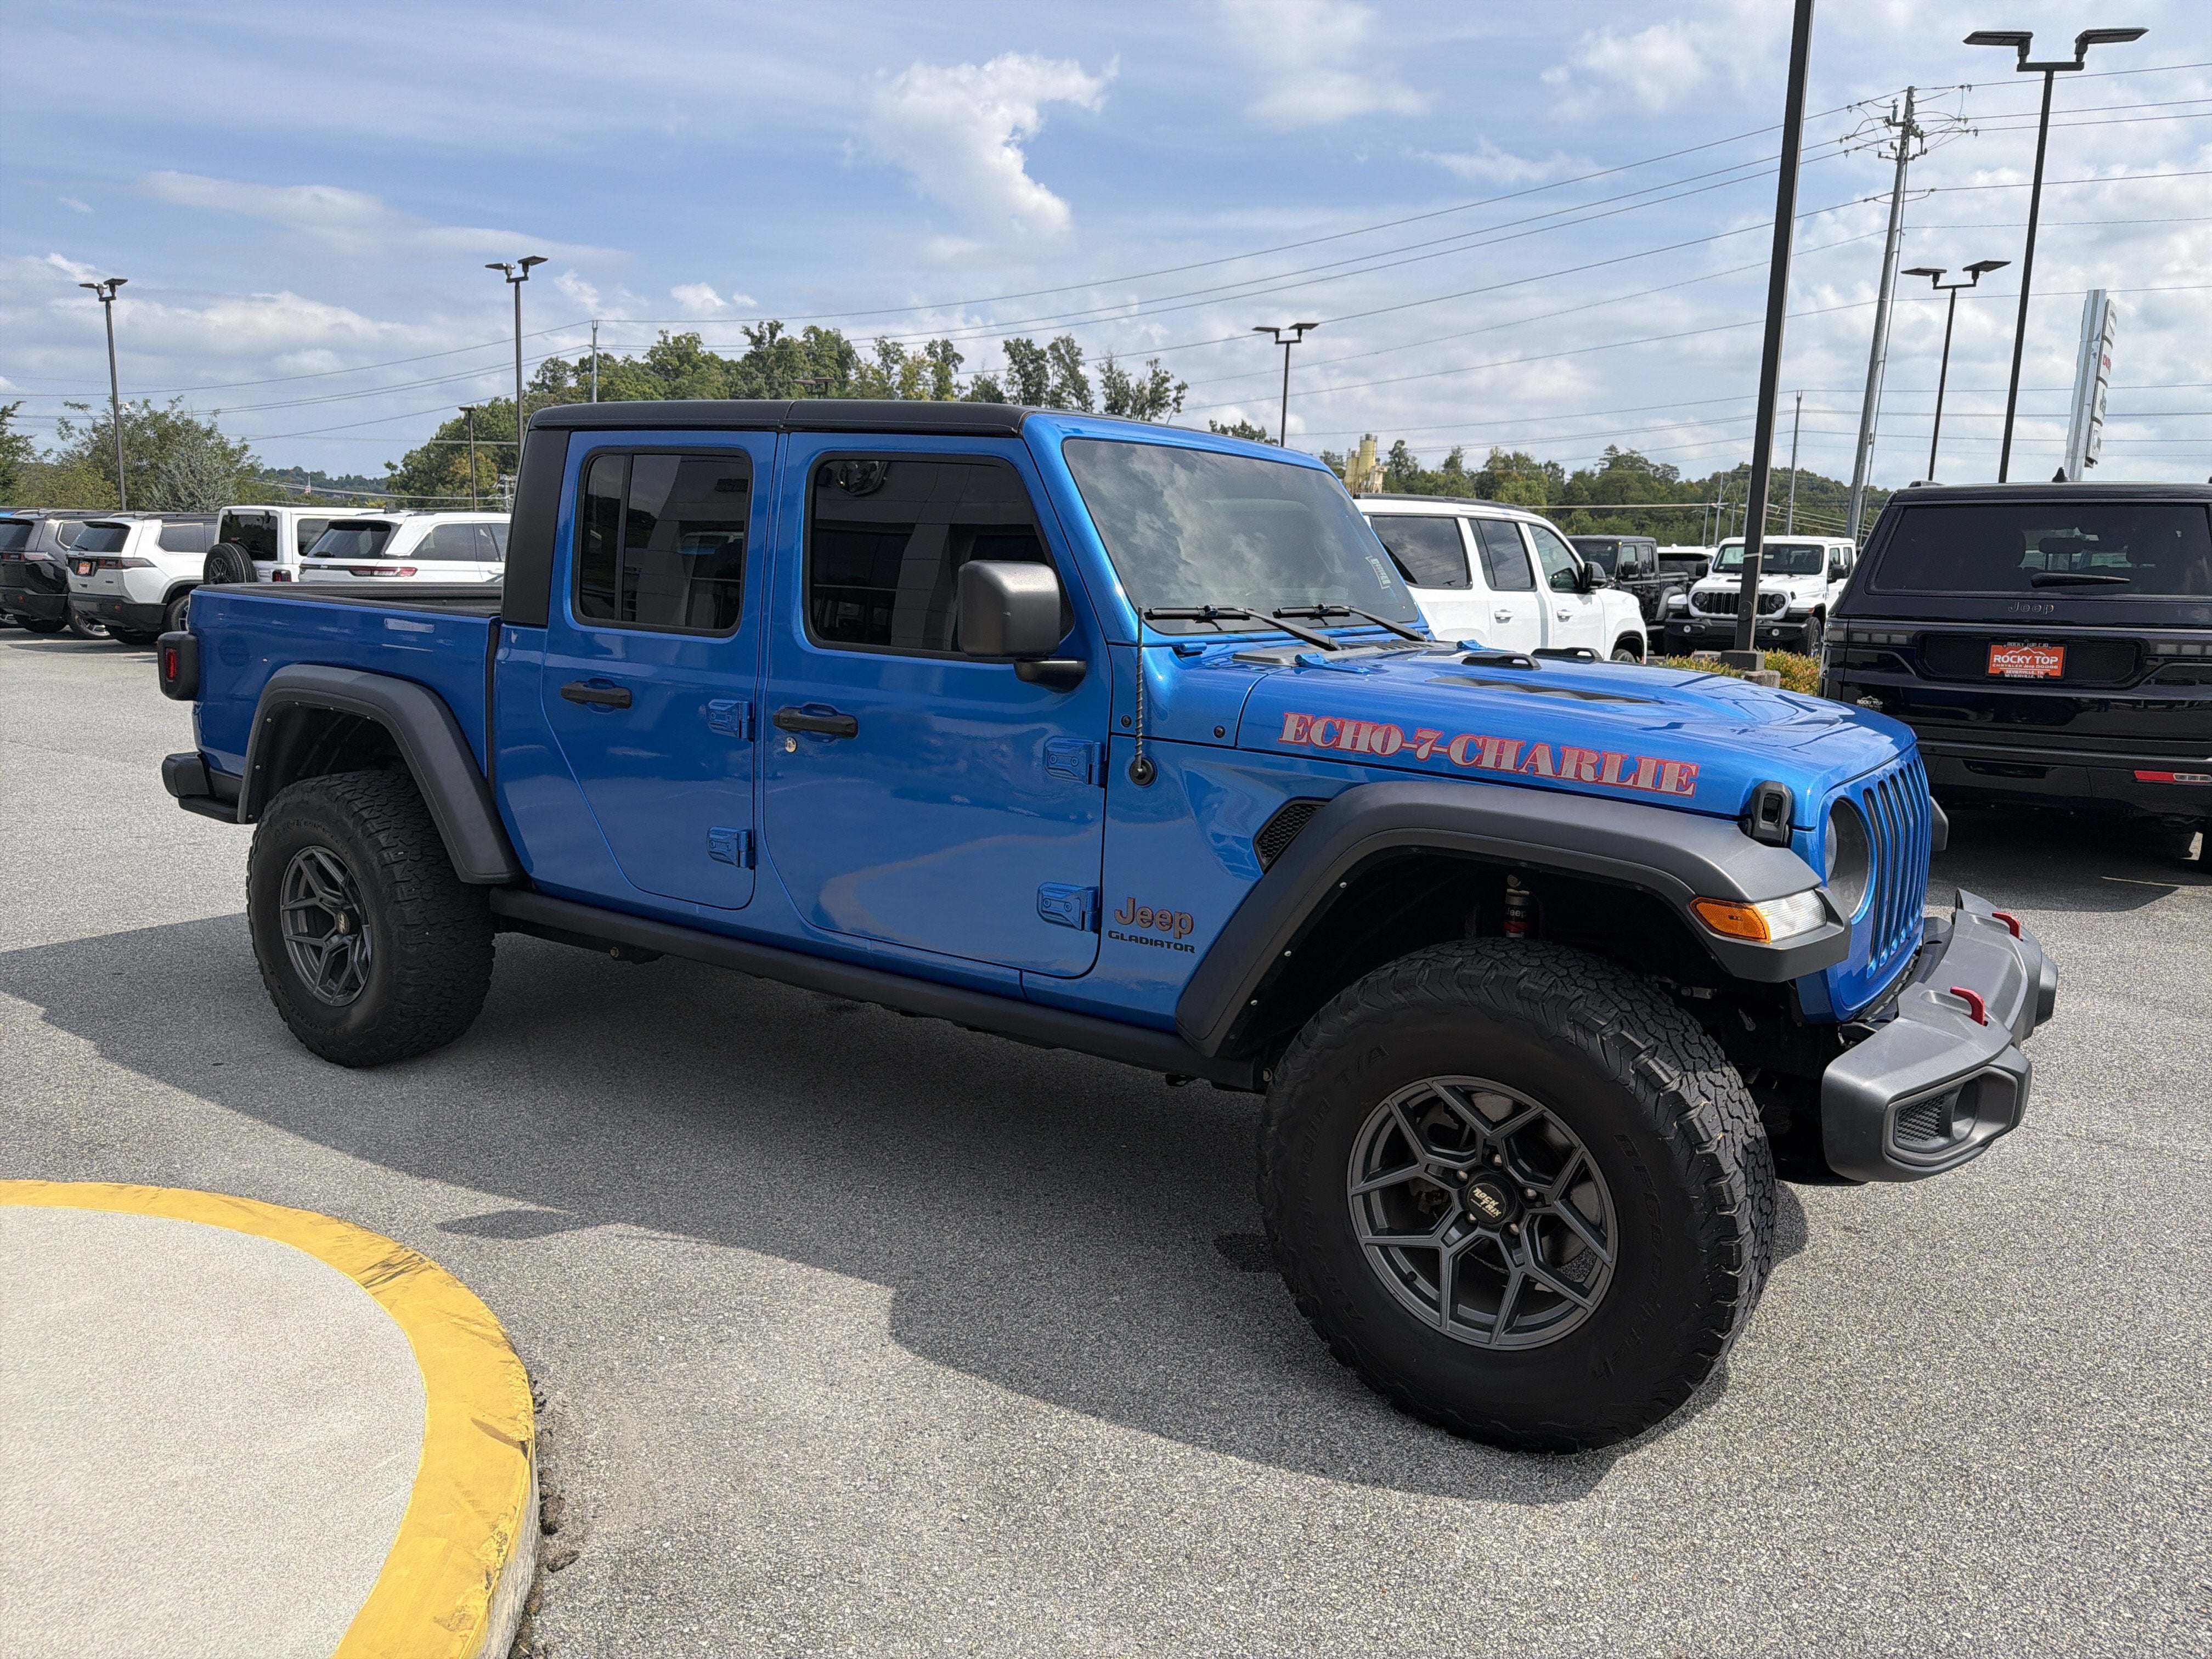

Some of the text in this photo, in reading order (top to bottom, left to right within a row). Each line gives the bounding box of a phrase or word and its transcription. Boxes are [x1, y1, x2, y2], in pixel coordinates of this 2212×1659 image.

[2008, 601, 2054, 614] Jeep
[1993, 654, 2058, 664] ROCKY TOP
[1278, 712, 1699, 797] ECHO-7-CHARLIE
[1114, 896, 1194, 939] Jeep
[1506, 907, 1527, 918] Jeep
[1108, 930, 1195, 953] GLADIATOR
[1472, 1187, 1499, 1206] ROCK
